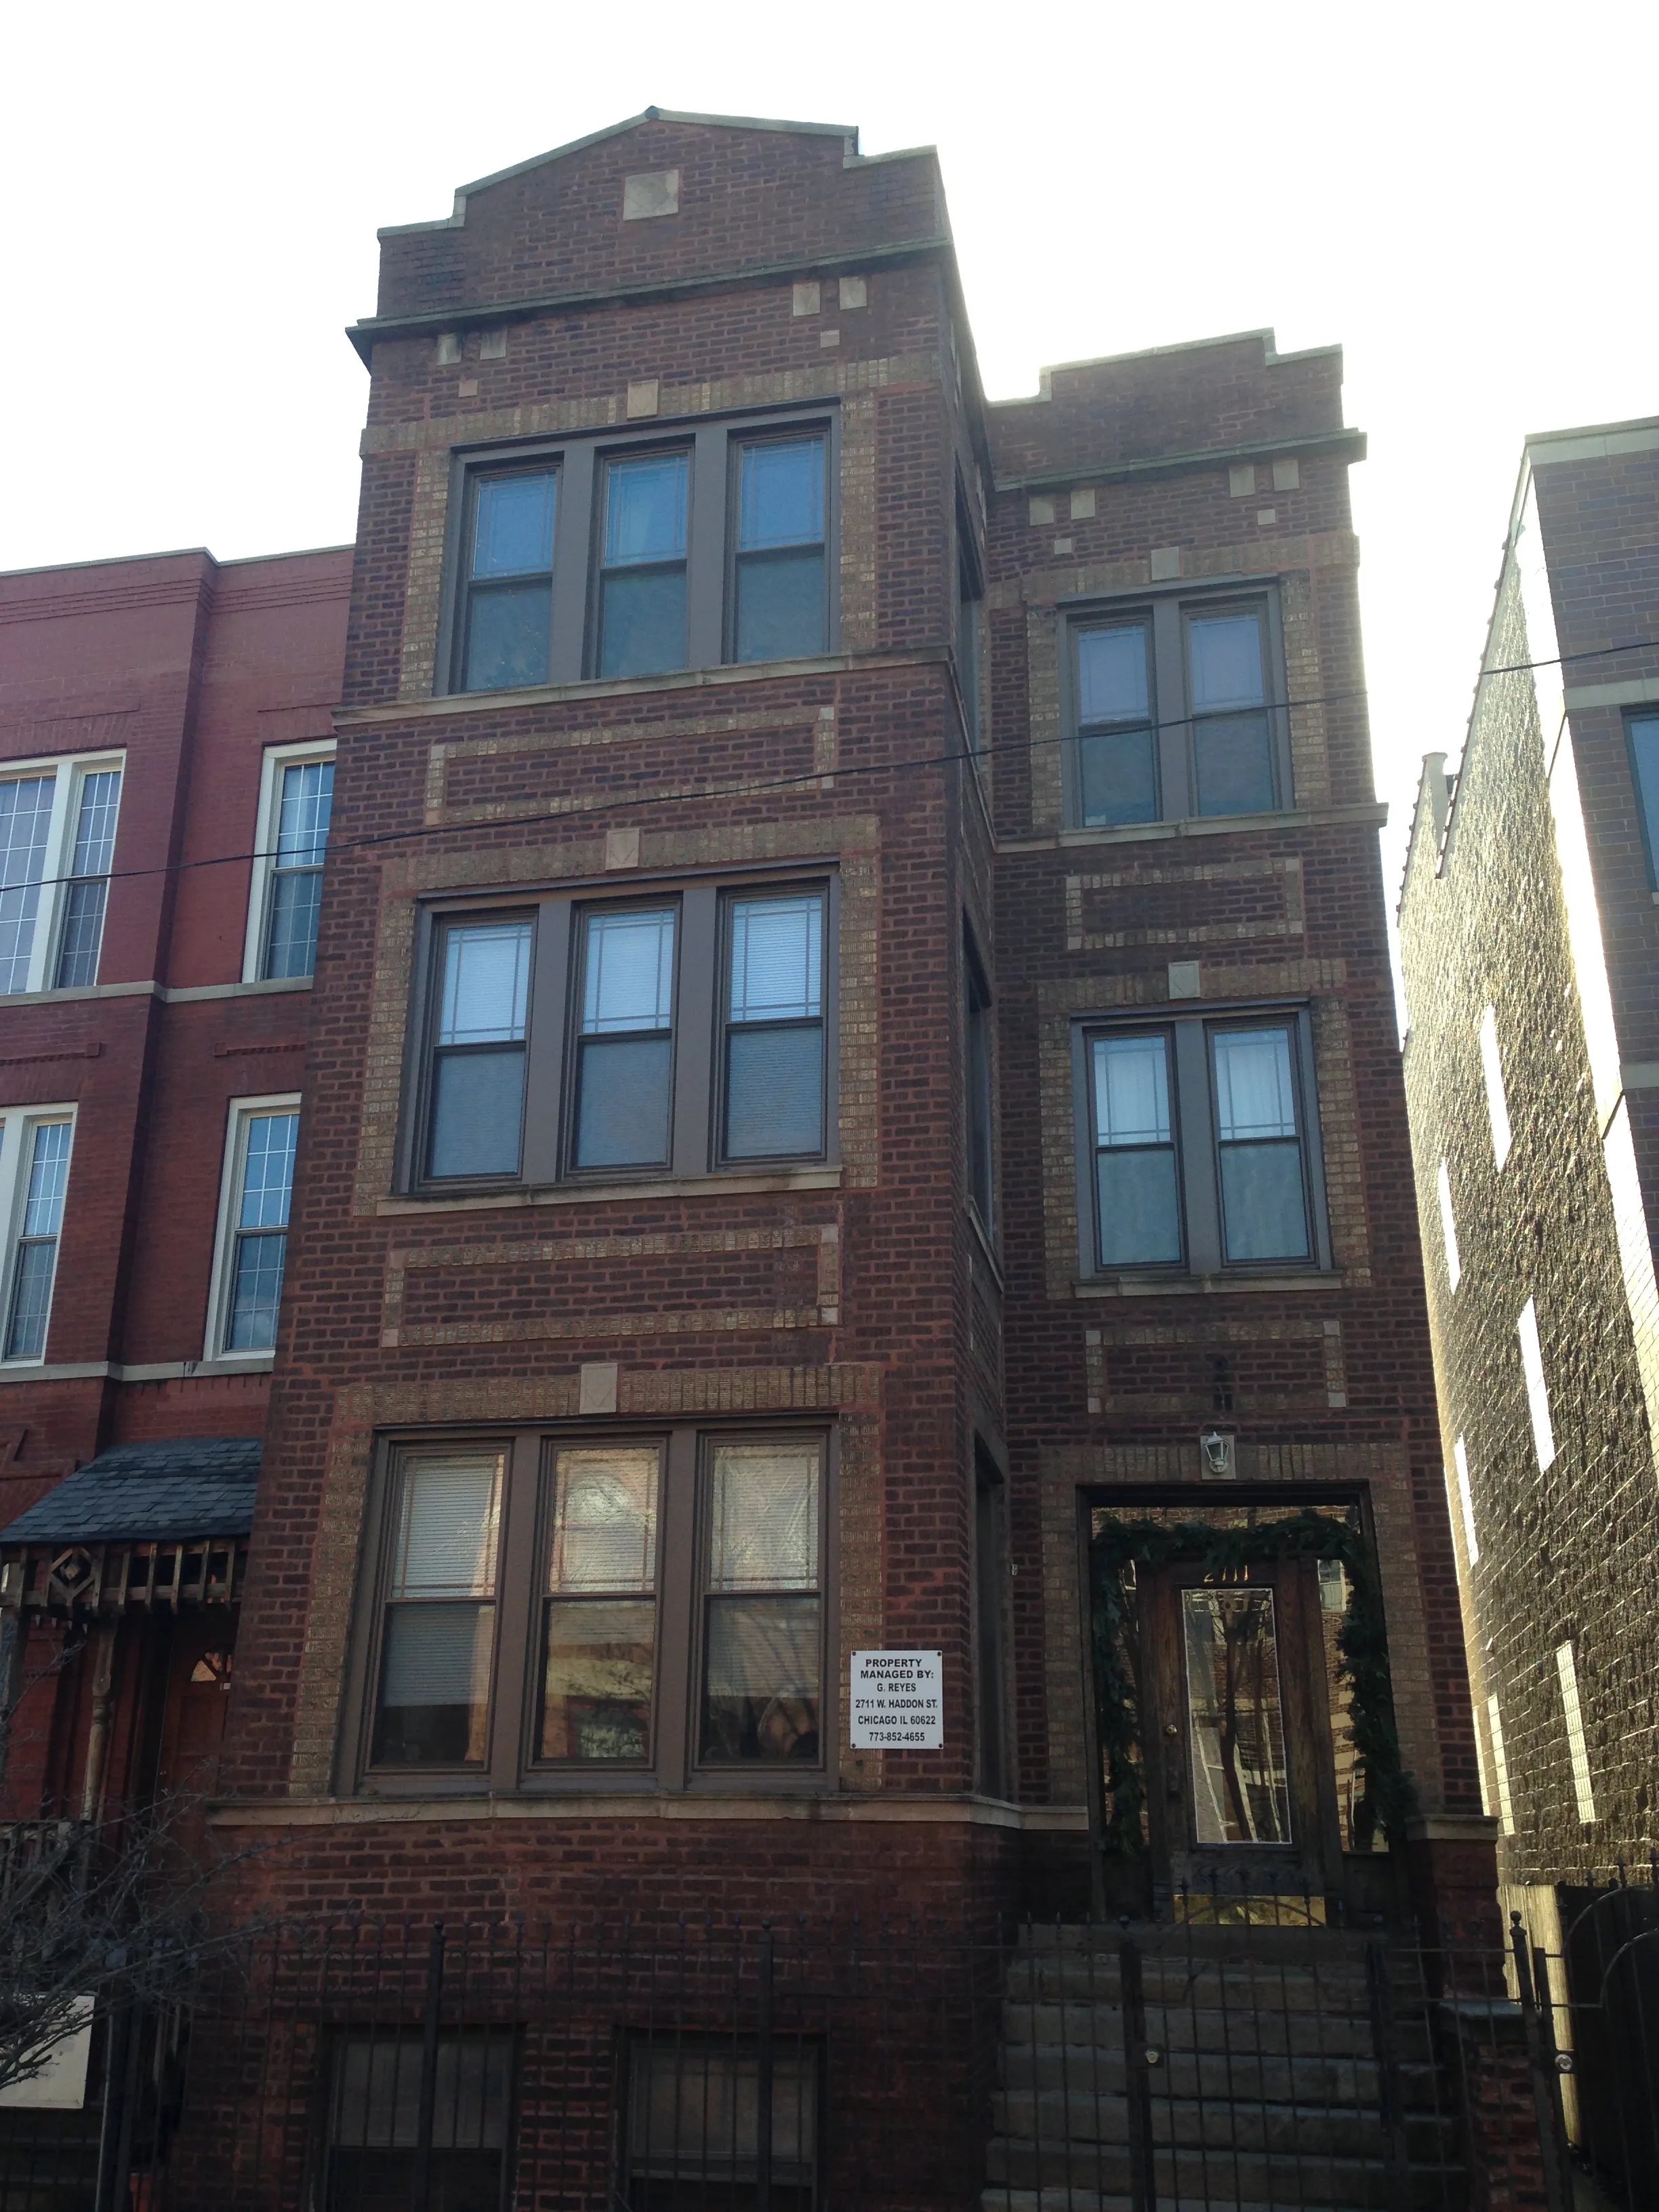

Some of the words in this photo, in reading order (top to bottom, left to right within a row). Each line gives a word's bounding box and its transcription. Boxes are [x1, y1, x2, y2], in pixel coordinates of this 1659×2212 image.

[865, 1659, 922, 1667] PROPERTY
[860, 1671, 913, 1679] MANAGED
[917, 1671, 934, 1679] BY:
[877, 1683, 886, 1692] G.
[888, 1683, 916, 1692] REYES
[855, 1700, 874, 1708] 2711
[877, 1700, 886, 1708] W.
[889, 1700, 924, 1708] HADDON
[926, 1700, 938, 1708] ST.
[858, 1716, 897, 1724] CHICAGO
[900, 1716, 907, 1724] IL
[910, 1716, 936, 1724] 60622
[869, 1732, 925, 1741] 773-852-4655
